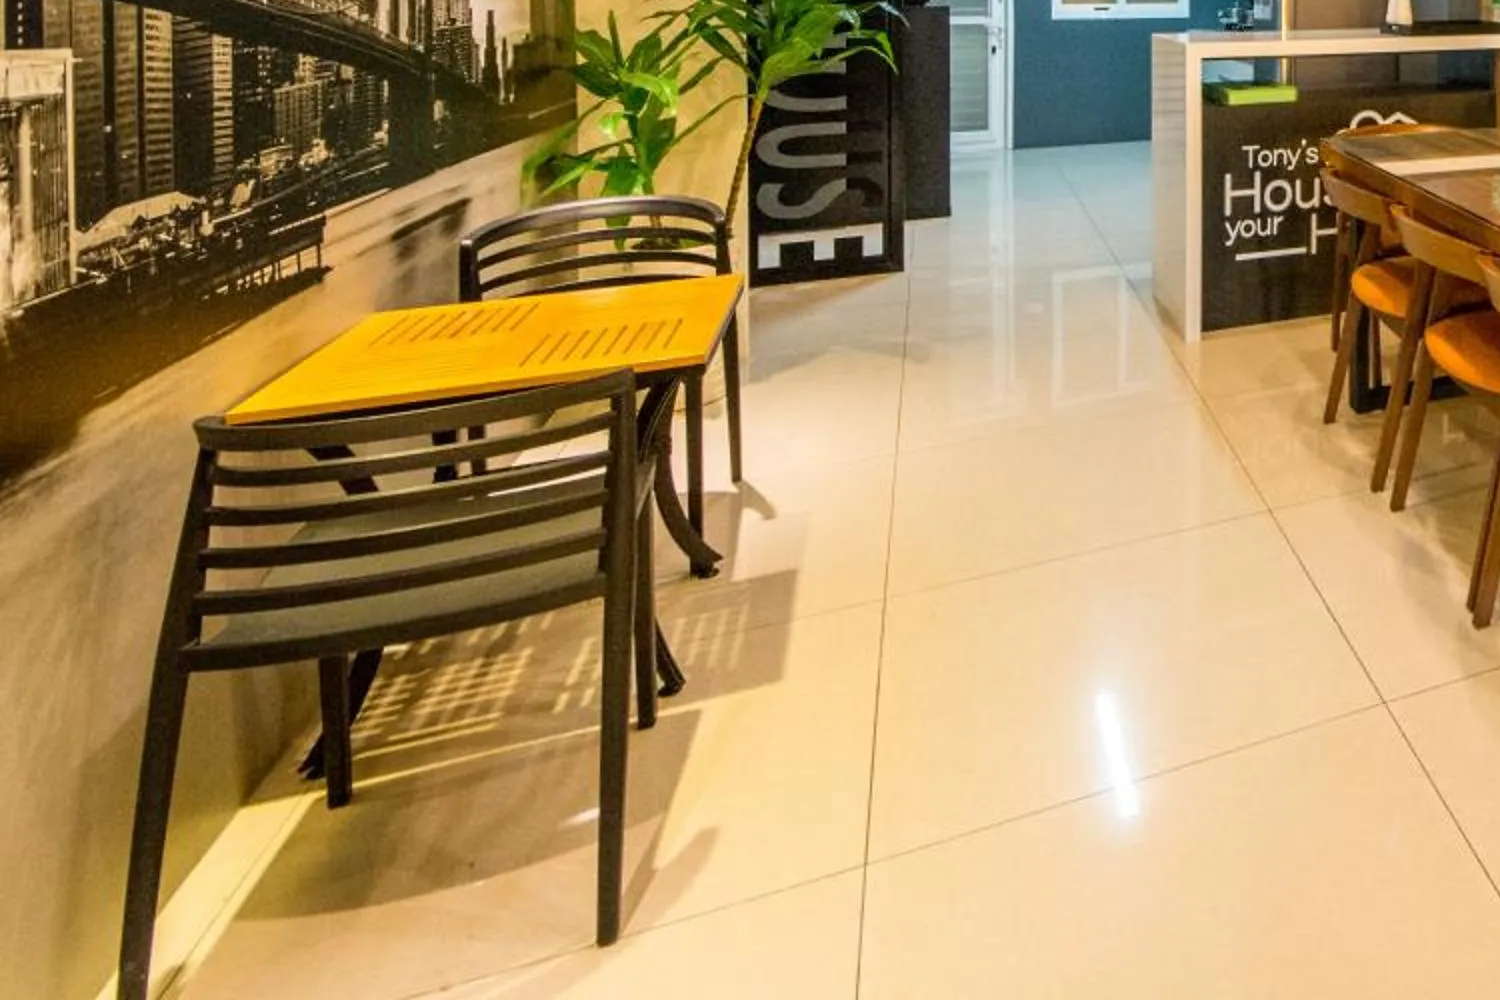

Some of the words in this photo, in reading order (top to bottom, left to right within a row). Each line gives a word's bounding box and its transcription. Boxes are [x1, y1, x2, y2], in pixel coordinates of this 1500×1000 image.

[1241, 139, 1319, 171] Tony's
[1224, 171, 1336, 216] Hou
[1224, 214, 1284, 246] your
